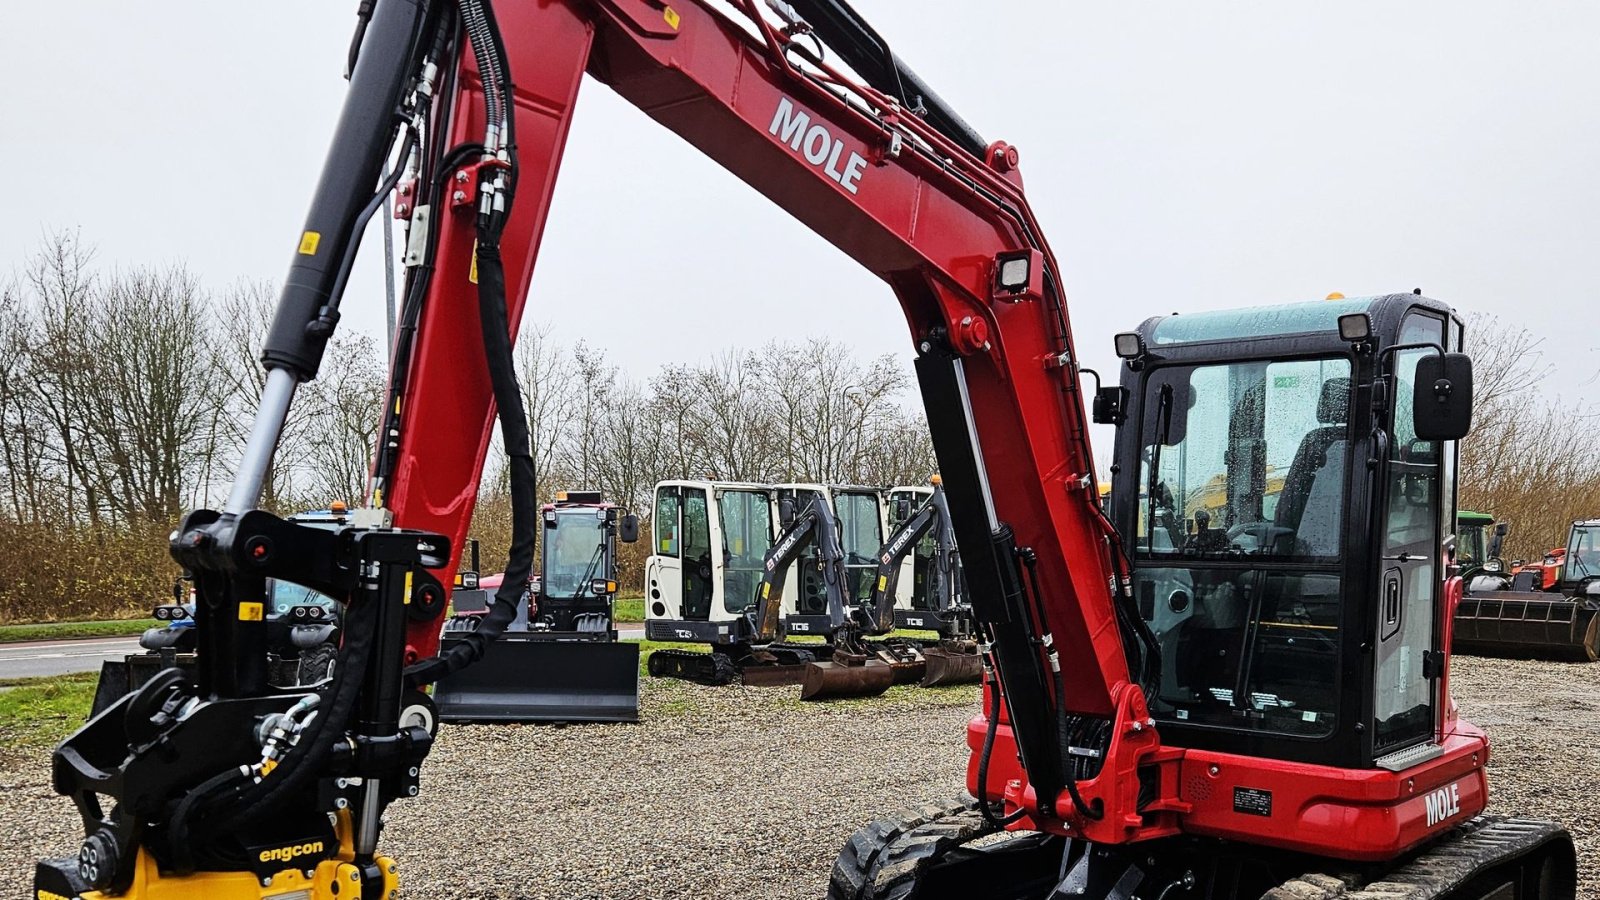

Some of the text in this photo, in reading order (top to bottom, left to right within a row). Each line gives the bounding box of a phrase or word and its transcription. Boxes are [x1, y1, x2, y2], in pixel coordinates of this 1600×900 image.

[768, 97, 868, 195] MOLE
[772, 532, 796, 562] TEREX
[888, 525, 914, 555] TEREX
[1424, 783, 1460, 828] MOLE
[259, 841, 324, 862] engcon
